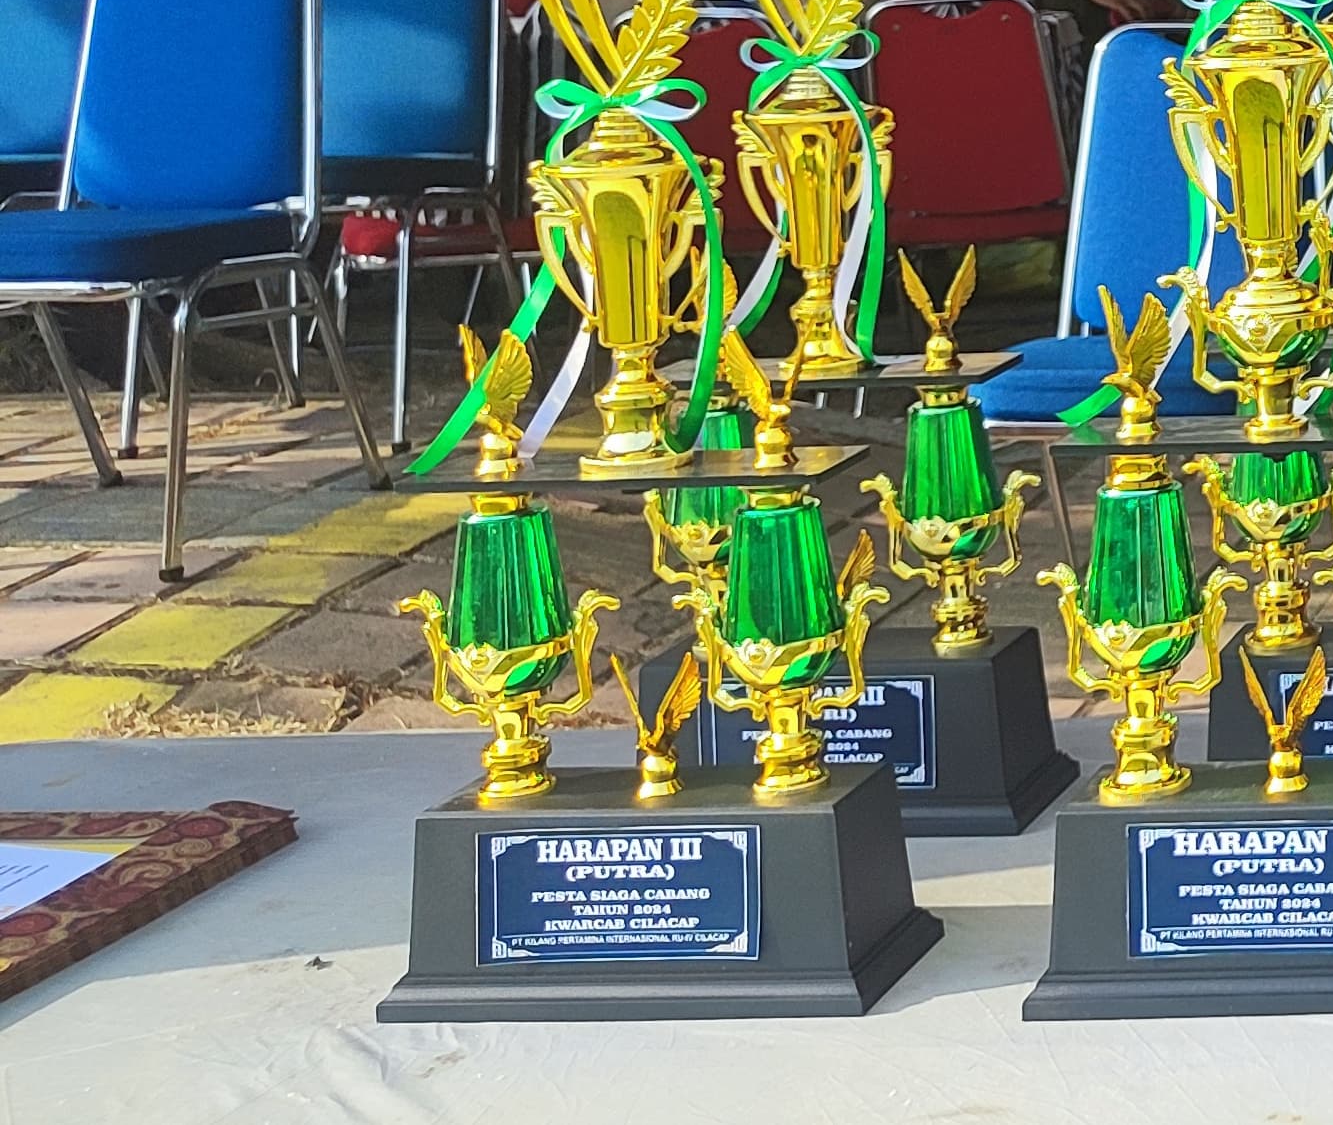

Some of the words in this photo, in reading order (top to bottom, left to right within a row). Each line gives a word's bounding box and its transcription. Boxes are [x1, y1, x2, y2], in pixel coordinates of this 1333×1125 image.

[836, 729, 892, 738] CABANG
[827, 742, 859, 751] 2024
[824, 753, 883, 763] CILACAP
[1173, 830, 1328, 856] HARAPAN
[537, 838, 664, 863] HARAPAN
[670, 837, 702, 860] III
[566, 864, 675, 882] (PUTRA)
[1213, 858, 1325, 876] (PUTRA)
[531, 891, 587, 903] PESTA
[590, 890, 641, 901] SIAGA
[643, 888, 710, 900] CABANG
[1179, 885, 1234, 897] PESTA
[1237, 883, 1290, 896] SIAGA
[573, 905, 628, 916] TAHUN
[634, 904, 671, 915] 2024
[1219, 899, 1277, 911] TAHUN
[1282, 898, 1321, 909] 2024
[545, 920, 625, 932] KWARCAB
[630, 918, 699, 929] CILACAP
[1192, 913, 1274, 926] KWARCAB
[512, 938, 522, 946] PT
[525, 937, 556, 946] KILANG
[558, 935, 604, 945] PERTAMINA
[606, 934, 670, 944] INTERNASIONAL
[695, 933, 730, 943] CILACAP
[1160, 931, 1171, 940] PT
[1173, 930, 1204, 940] KILANG
[1206, 928, 1252, 939] PERTAMINA
[1254, 927, 1319, 938] INTERNASIONAL
